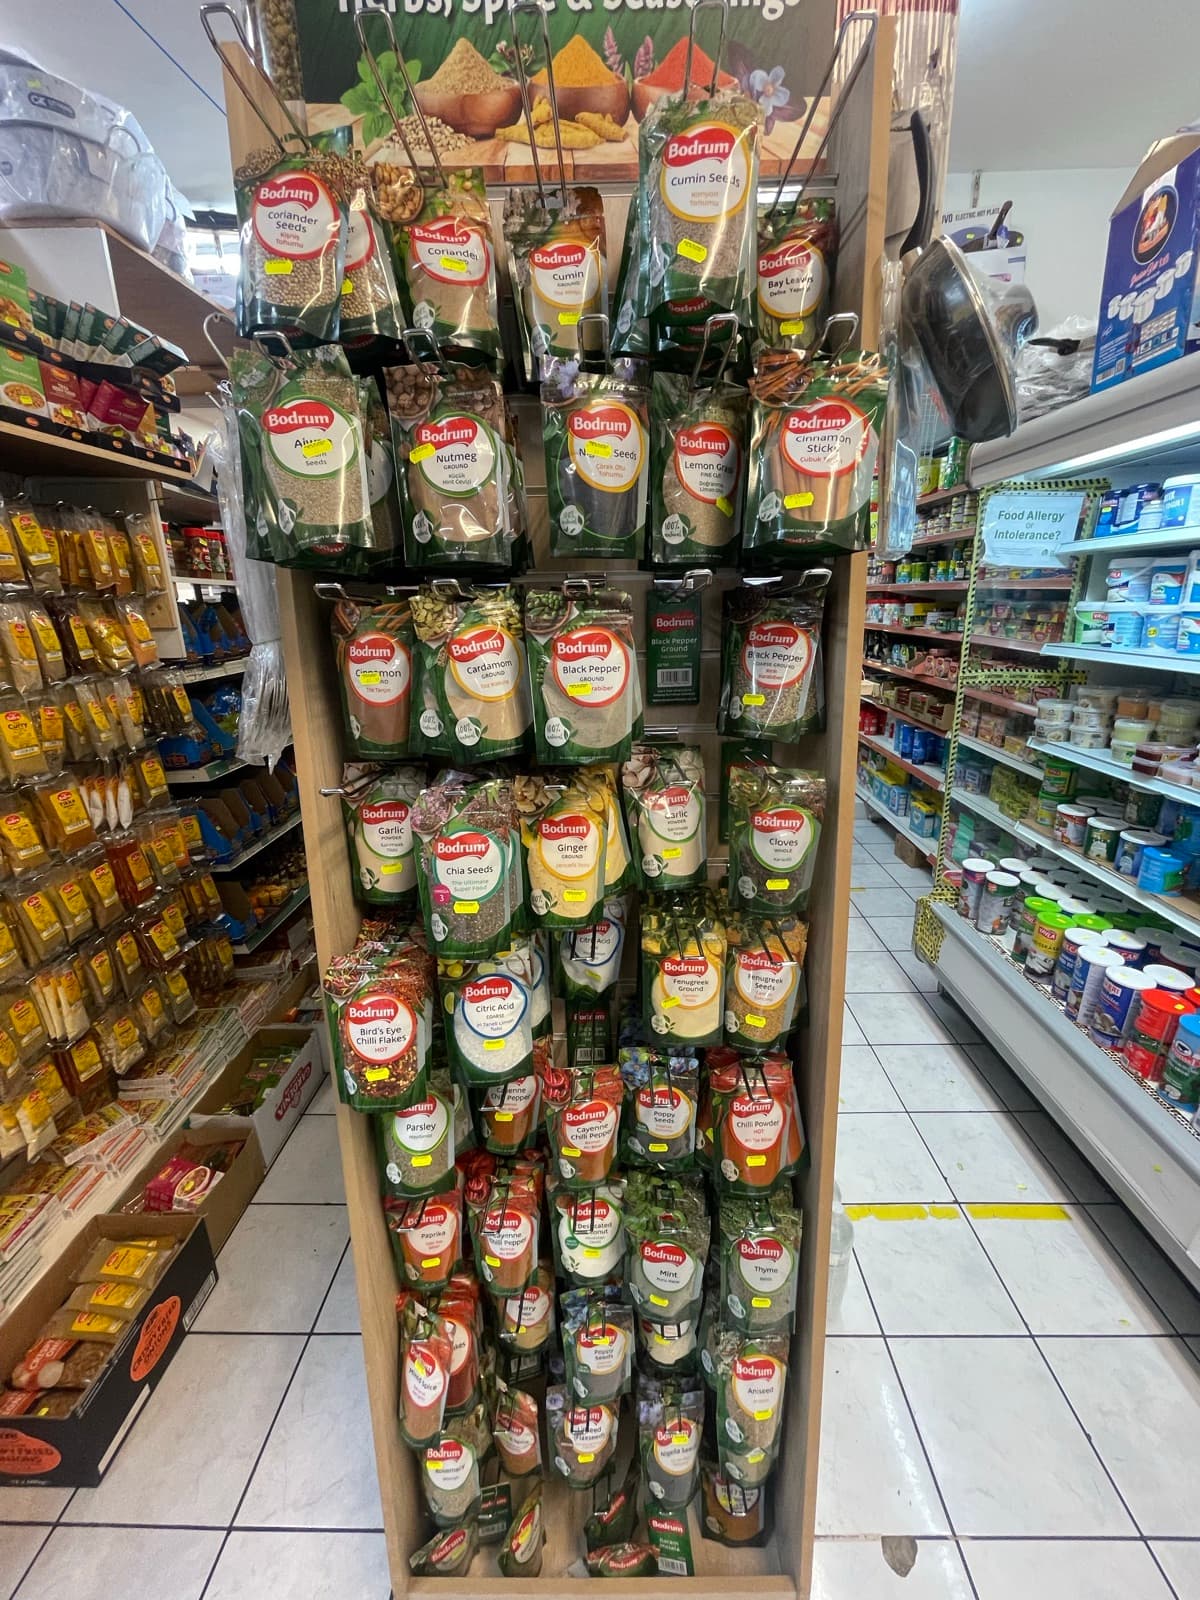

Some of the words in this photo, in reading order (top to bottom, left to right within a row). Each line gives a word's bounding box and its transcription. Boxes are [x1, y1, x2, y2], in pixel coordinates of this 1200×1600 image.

[668, 140, 729, 158] Bodrum
[671, 173, 707, 187] Cumin
[709, 173, 741, 188] Seeds
[259, 187, 314, 203] Bodrum
[267, 211, 319, 226] Coriander
[275, 221, 308, 234] Seeds
[413, 227, 467, 244] Bodrum
[427, 246, 480, 262] Coriander
[534, 251, 583, 265] Bodrum
[759, 255, 806, 271] Bodrum
[552, 269, 585, 282] Cumin
[768, 280, 784, 289] Bay
[267, 411, 329, 427] Bodrum
[573, 417, 627, 432] Bodrum
[788, 414, 847, 429] Bodrum
[421, 428, 473, 442] Bodrum
[795, 434, 852, 445] Cinnamon
[679, 436, 726, 450] Bodrum
[435, 451, 478, 464] Nutmeg
[613, 448, 638, 461] Seeds
[684, 461, 715, 471] Lemon
[997, 510, 1024, 521] Food
[1028, 510, 1065, 524] Allergy
[663, 519, 680, 531] 100%
[993, 529, 1061, 541] Intolerance?
[655, 617, 695, 628] Bodrum
[672, 637, 698, 647] Pepper
[748, 631, 795, 644] Bodrum
[349, 645, 391, 658] Bodrum
[451, 637, 502, 658] Bodrum
[557, 641, 608, 656] Bodrum
[661, 644, 688, 654] Ground
[747, 649, 771, 660] Black
[772, 652, 804, 664] Pepper
[466, 659, 514, 675] Cardamom
[562, 664, 586, 675] Black
[587, 664, 622, 676] Pepper
[481, 670, 506, 680] GROUND
[579, 675, 605, 683] GROUND
[457, 722, 473, 733] 100%
[362, 808, 406, 819] Bodrum
[755, 815, 801, 829] Bodrum
[378, 826, 405, 835] Garlic
[542, 823, 588, 835] Bodrum
[769, 837, 799, 847] Cloves
[437, 842, 486, 855] Bodrum
[557, 843, 588, 855] Ginger
[446, 866, 465, 876] Chia
[467, 865, 494, 875] Seeds
[439, 894, 445, 902] 3
[664, 962, 705, 973] Bodrum
[673, 978, 709, 987] Fenugreek
[748, 973, 783, 984] Fenugreek
[465, 985, 509, 998] Bodrum
[678, 985, 704, 994] Ground
[755, 981, 776, 991] Seeds
[349, 1006, 395, 1018] Bodrum
[476, 1004, 496, 1014] Citric
[497, 1002, 515, 1012] Acid
[359, 1027, 384, 1036] Bird's
[386, 1026, 402, 1036] Eye
[356, 1036, 378, 1046] Chilli
[379, 1034, 407, 1044] Flakes
[507, 1093, 531, 1102] Pepper
[734, 1100, 771, 1112] Bodrum
[566, 1110, 606, 1122] Bodrum
[653, 1111, 676, 1120] Poppy
[654, 1117, 674, 1125] Seeds
[406, 1122, 436, 1132] Parsley
[576, 1123, 609, 1135] Cayenne
[736, 1120, 754, 1129] Chilli
[754, 1119, 780, 1129] Powder
[570, 1132, 589, 1142] Chilli
[590, 1130, 614, 1141] Pepper
[485, 1216, 519, 1227] Bodum
[420, 1231, 447, 1241] Paprika
[504, 1238, 527, 1249] Pepper
[644, 1247, 683, 1262] Bodrum
[740, 1243, 780, 1258] Bodrum
[659, 1269, 678, 1279] Mint
[754, 1265, 778, 1276] Thyme
[736, 1363, 774, 1377] Bodrum
[747, 1386, 774, 1395] Aniseed
[426, 1447, 461, 1459] Bodrum
[652, 1519, 685, 1534] Bodrum
[431, 1534, 465, 1563] Bodrum
